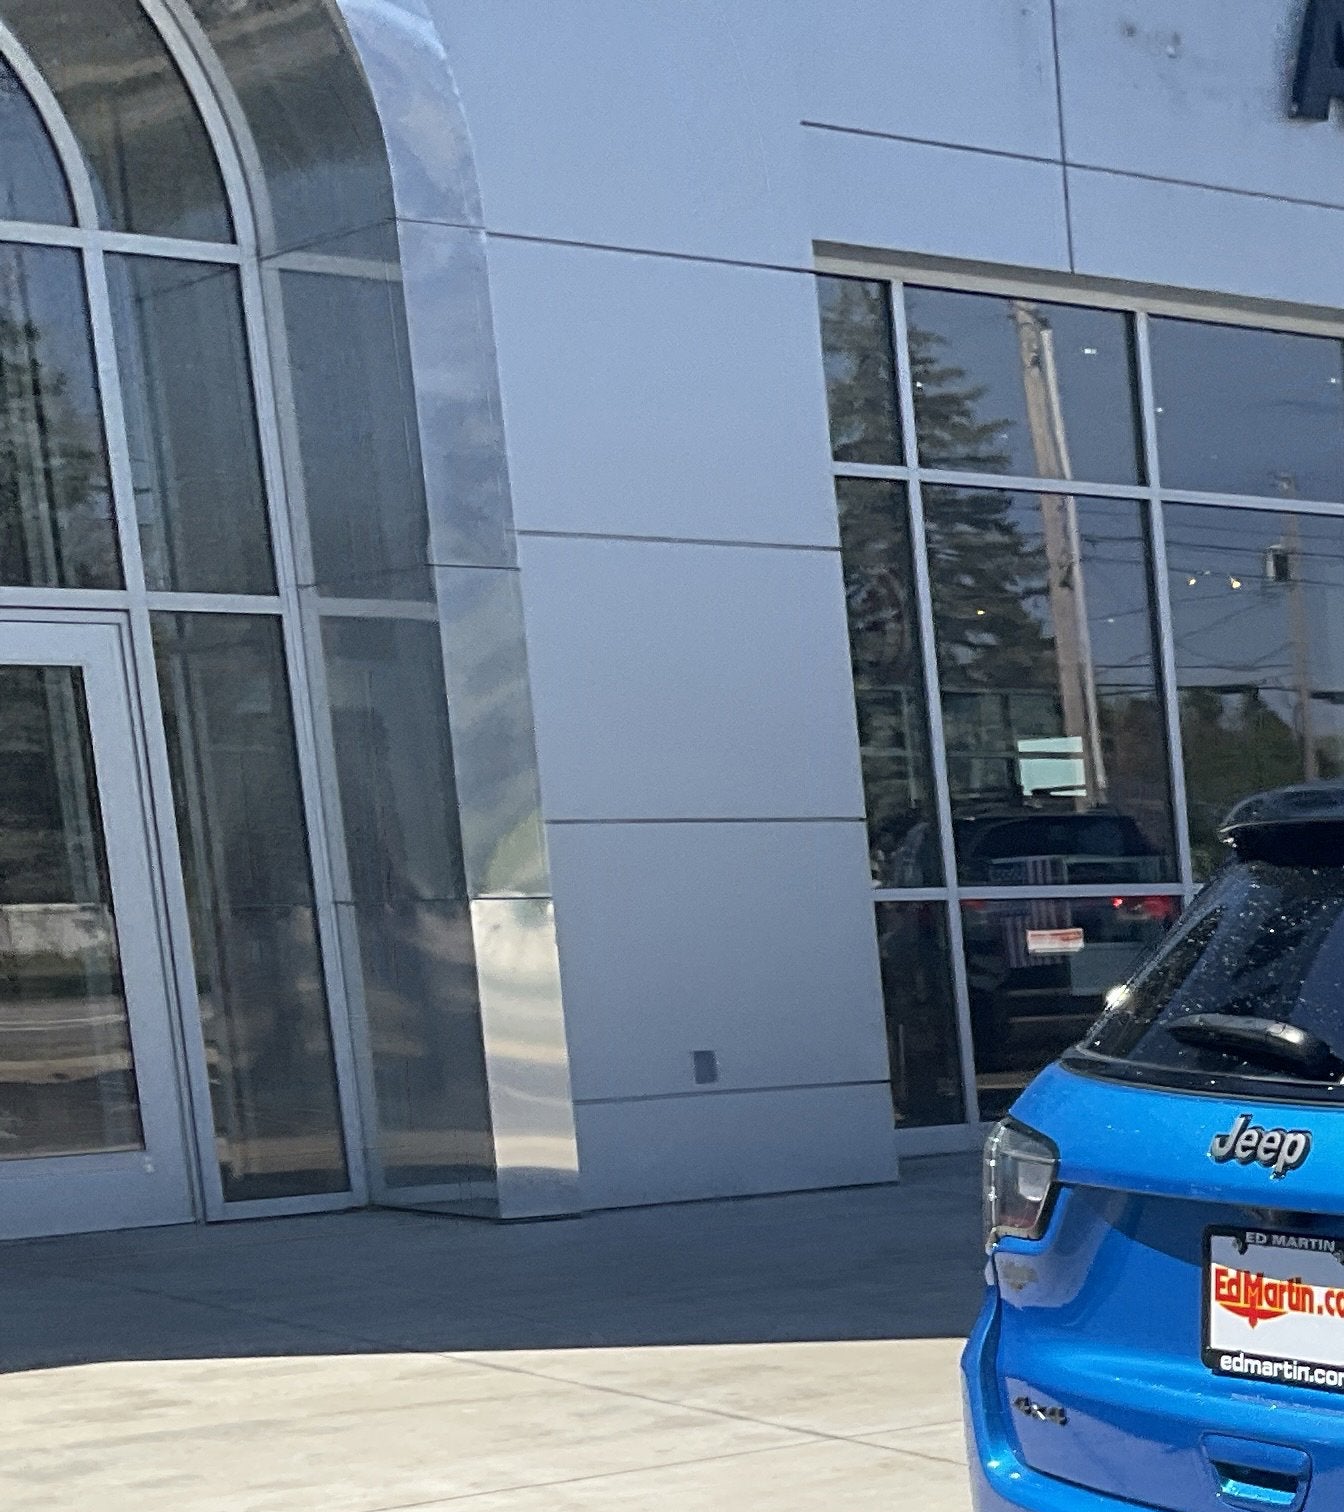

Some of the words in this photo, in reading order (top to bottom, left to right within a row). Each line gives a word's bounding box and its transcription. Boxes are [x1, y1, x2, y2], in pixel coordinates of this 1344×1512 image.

[1211, 1114, 1312, 1178] Jeep
[1245, 1231, 1266, 1244] ED
[1272, 1234, 1336, 1251] MARTIN
